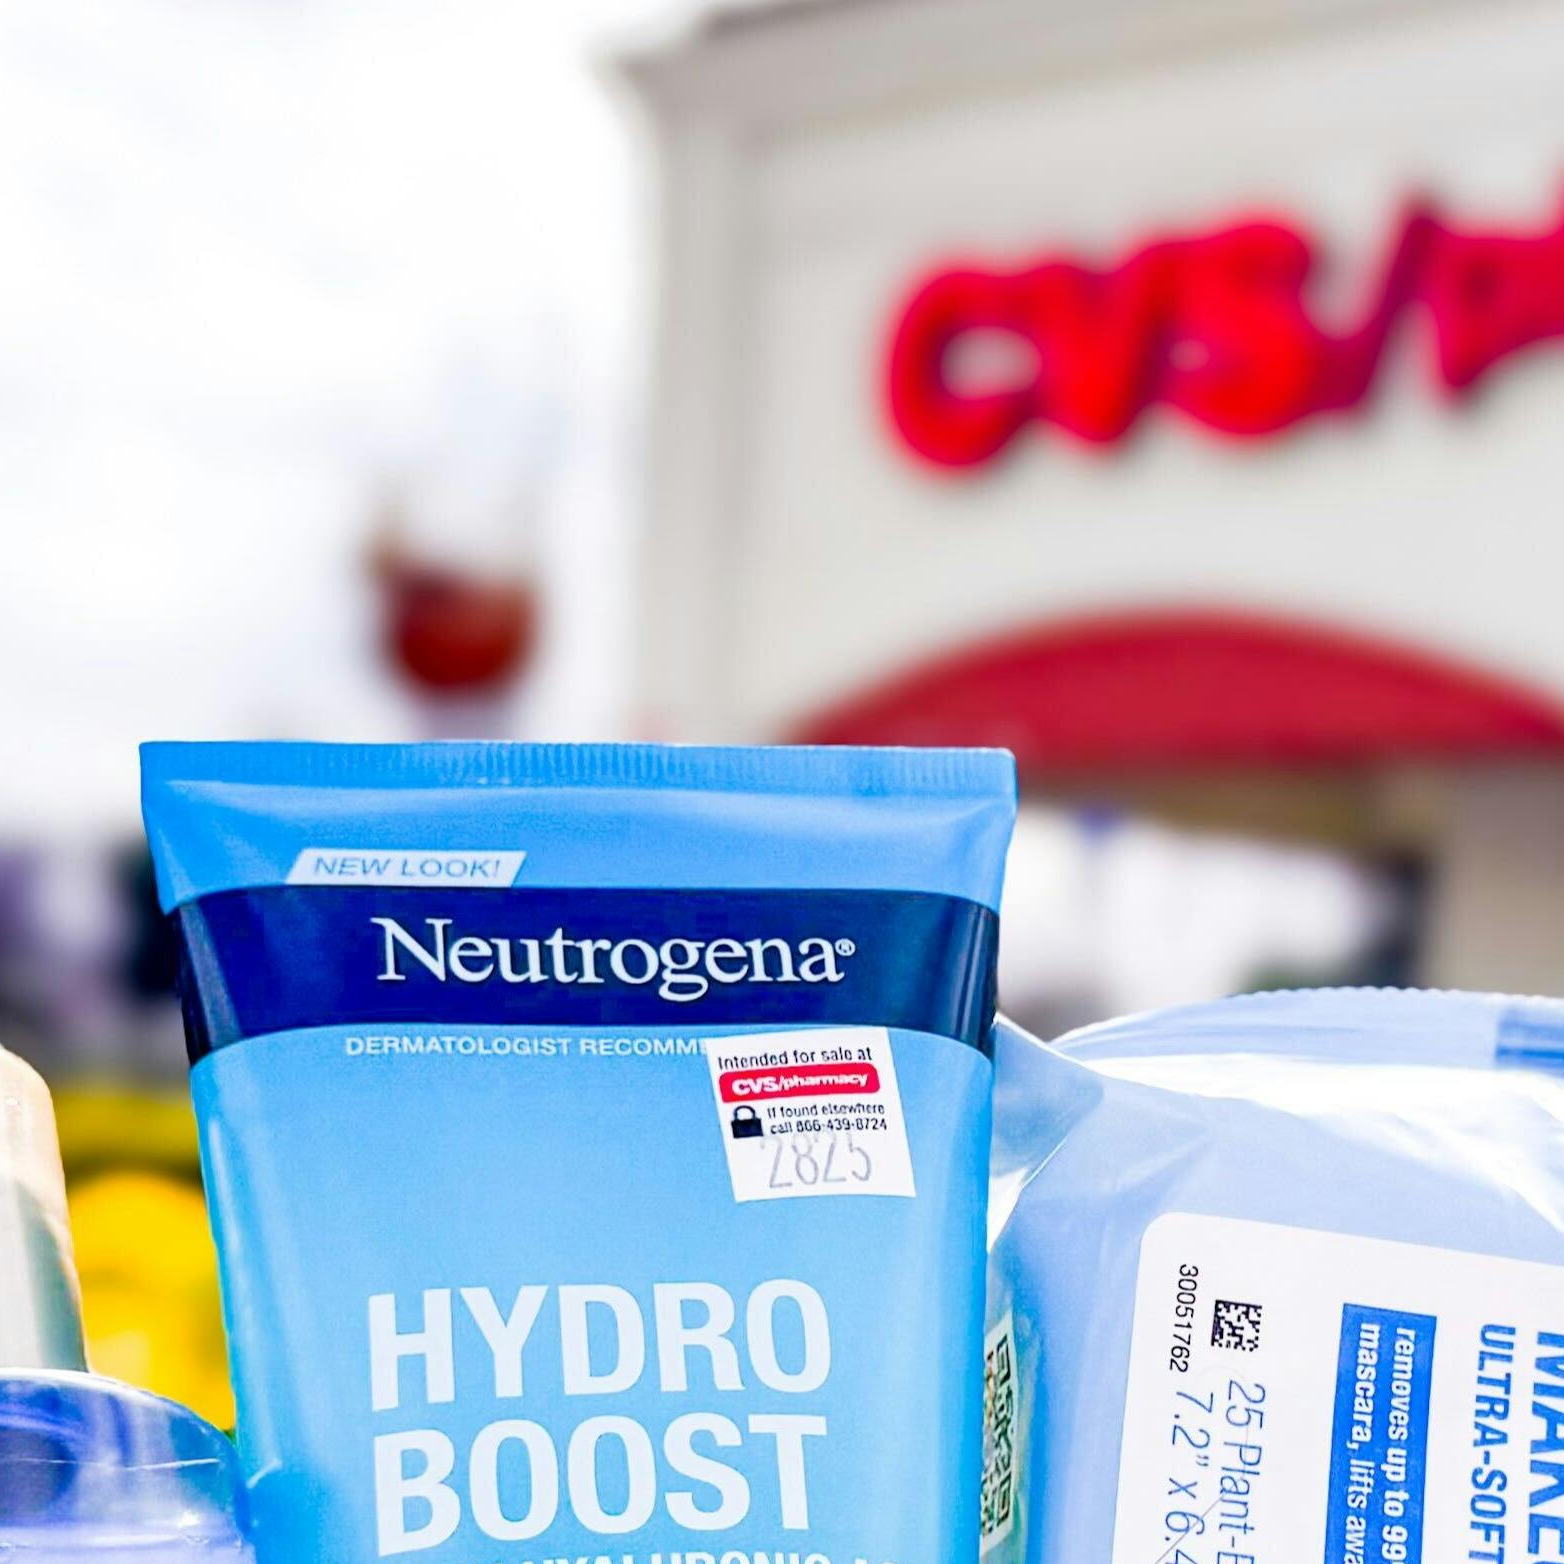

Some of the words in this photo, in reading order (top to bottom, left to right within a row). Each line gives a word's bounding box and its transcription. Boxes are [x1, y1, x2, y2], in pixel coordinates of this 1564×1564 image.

[314, 857, 391, 876] NEW
[400, 858, 501, 878] LOOK!
[344, 1035, 571, 1056] DERMATOLOGIST
[717, 1050, 788, 1070] Intended
[793, 1049, 815, 1064] for
[821, 1047, 852, 1062] sale
[857, 1047, 872, 1061] at
[732, 1073, 868, 1095] CVS/pharmacy
[780, 1105, 818, 1118] found
[822, 1102, 885, 1115] elsewhere
[770, 1122, 792, 1135] call
[1169, 1263, 1199, 1373] 30051762
[368, 1278, 832, 1412] HYDRO
[1346, 1322, 1380, 1451] mascara,
[1387, 1327, 1416, 1442] removes
[1225, 1379, 1266, 1429] 25
[1380, 1448, 1408, 1482] up
[373, 1412, 828, 1556] BOOST
[1167, 1476, 1198, 1500] x
[1347, 1458, 1375, 1511] lifts
[1383, 1490, 1410, 1518] to
